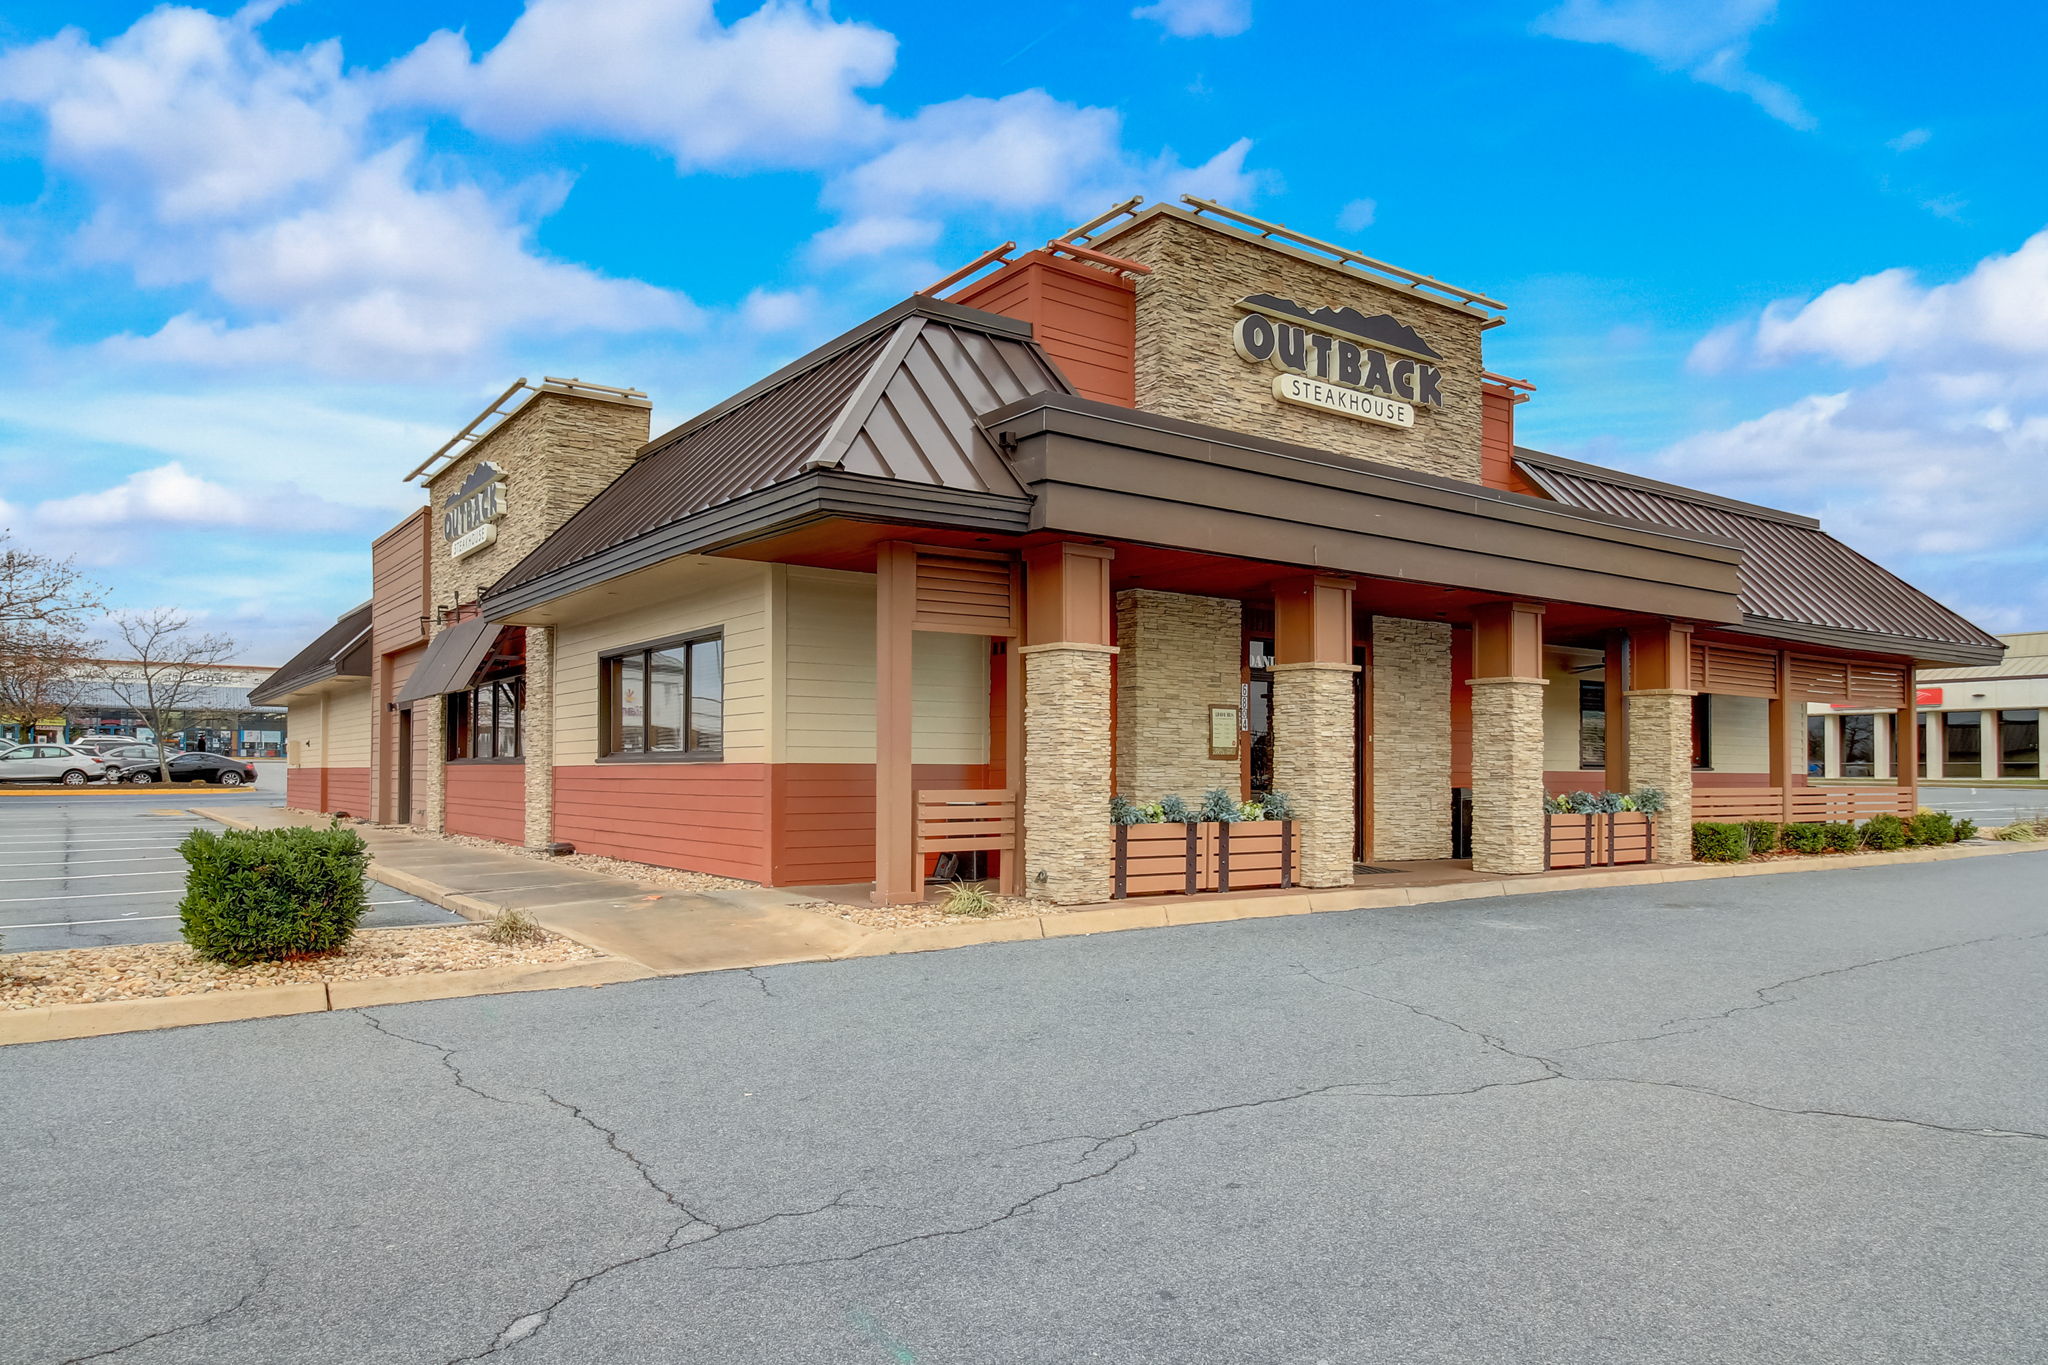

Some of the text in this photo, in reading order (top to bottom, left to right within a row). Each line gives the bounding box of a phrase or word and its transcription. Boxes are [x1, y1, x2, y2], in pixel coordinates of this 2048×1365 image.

[1236, 314, 1444, 408] OUTBACK
[1292, 380, 1405, 422] STEAKHOUSE
[444, 483, 499, 541] OUTBACK
